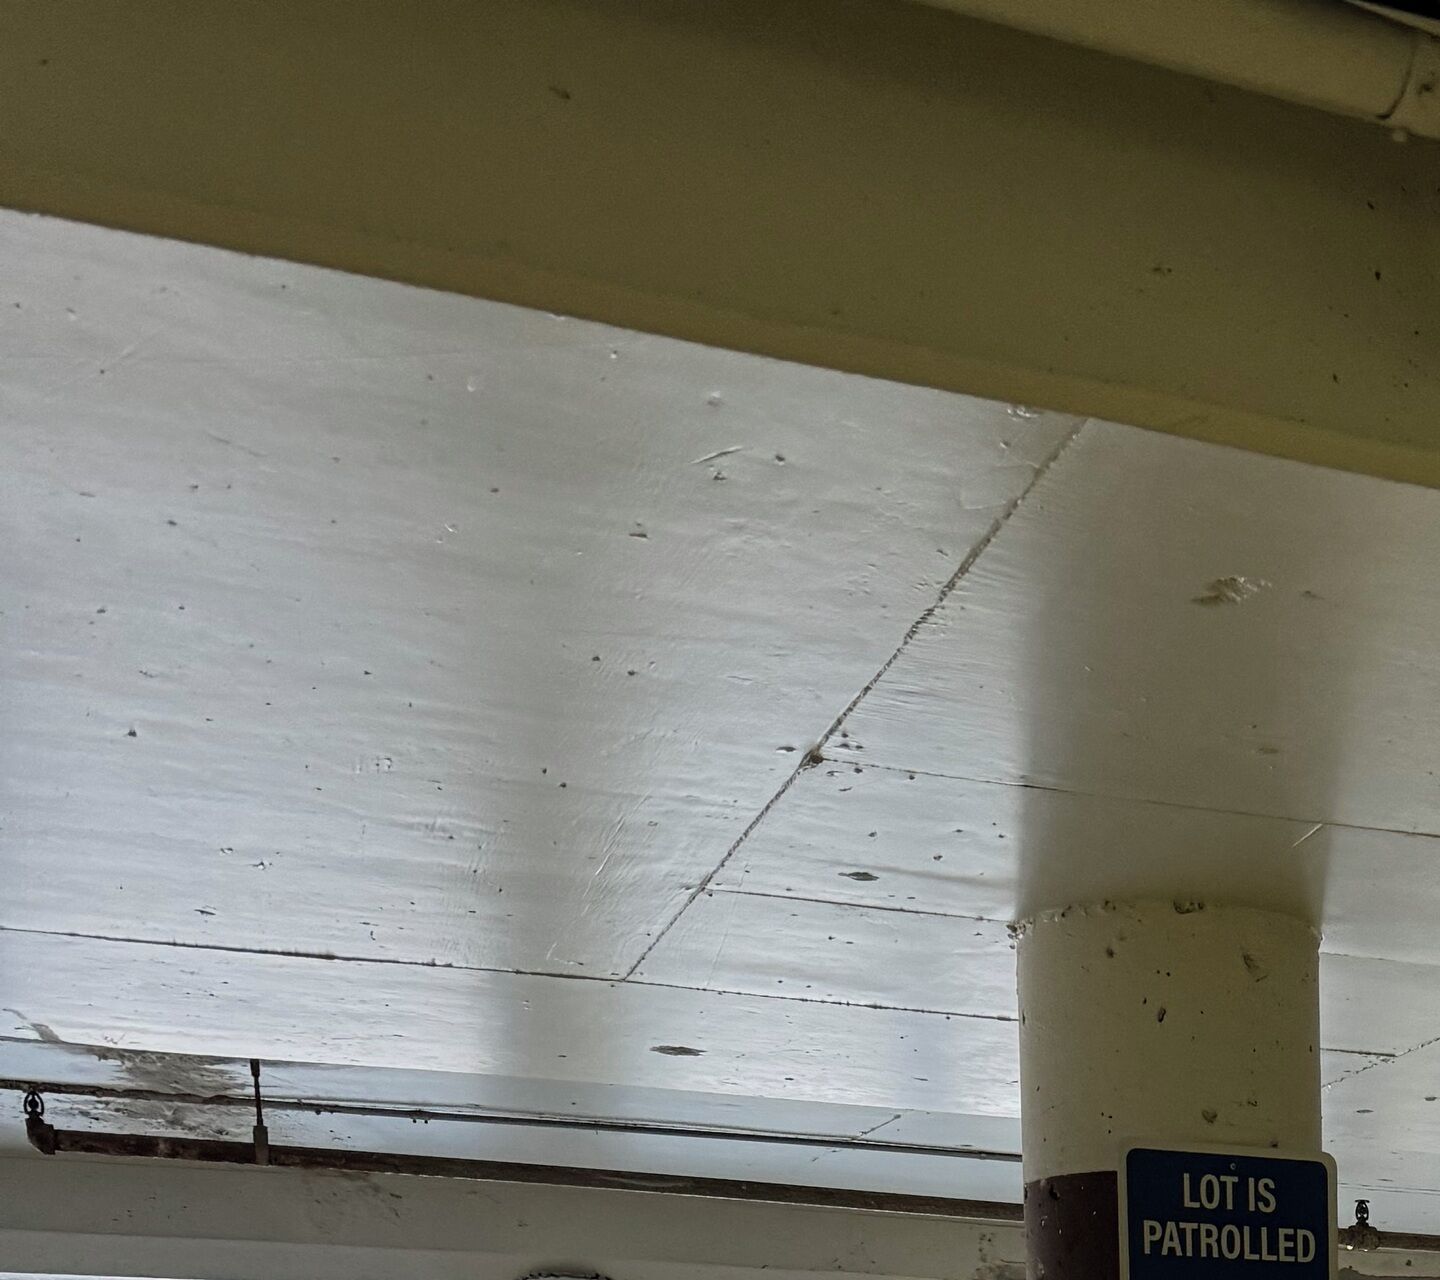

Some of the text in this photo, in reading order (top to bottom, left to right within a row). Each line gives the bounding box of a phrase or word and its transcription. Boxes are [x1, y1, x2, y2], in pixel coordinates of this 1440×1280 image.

[1183, 1172, 1277, 1213] LOT IS
[1143, 1219, 1316, 1263] PATROLLED
